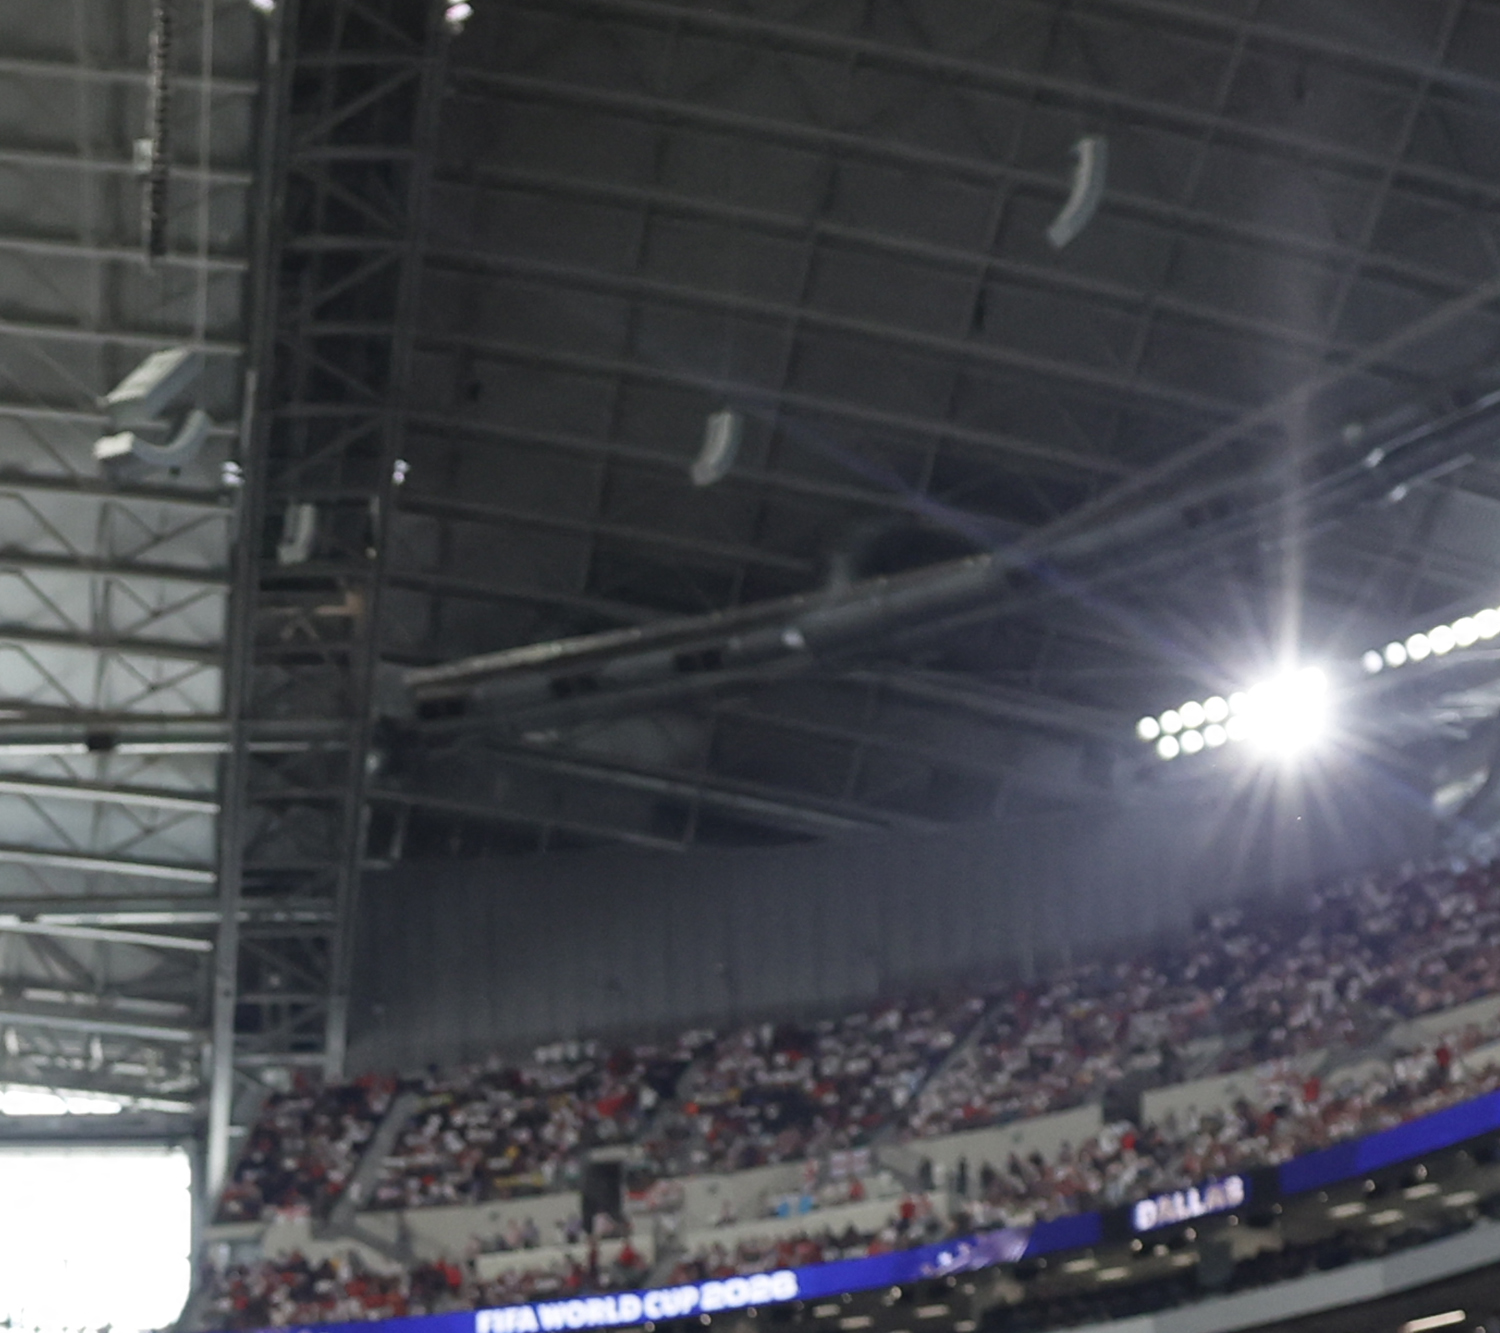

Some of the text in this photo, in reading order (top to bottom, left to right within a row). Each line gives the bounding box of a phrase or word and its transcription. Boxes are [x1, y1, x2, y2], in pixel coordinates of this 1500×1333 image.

[1133, 1175, 1245, 1231] DALLAS
[538, 1295, 643, 1331] WORLD
[643, 1284, 700, 1320] CUP
[700, 1269, 798, 1314] 2026
